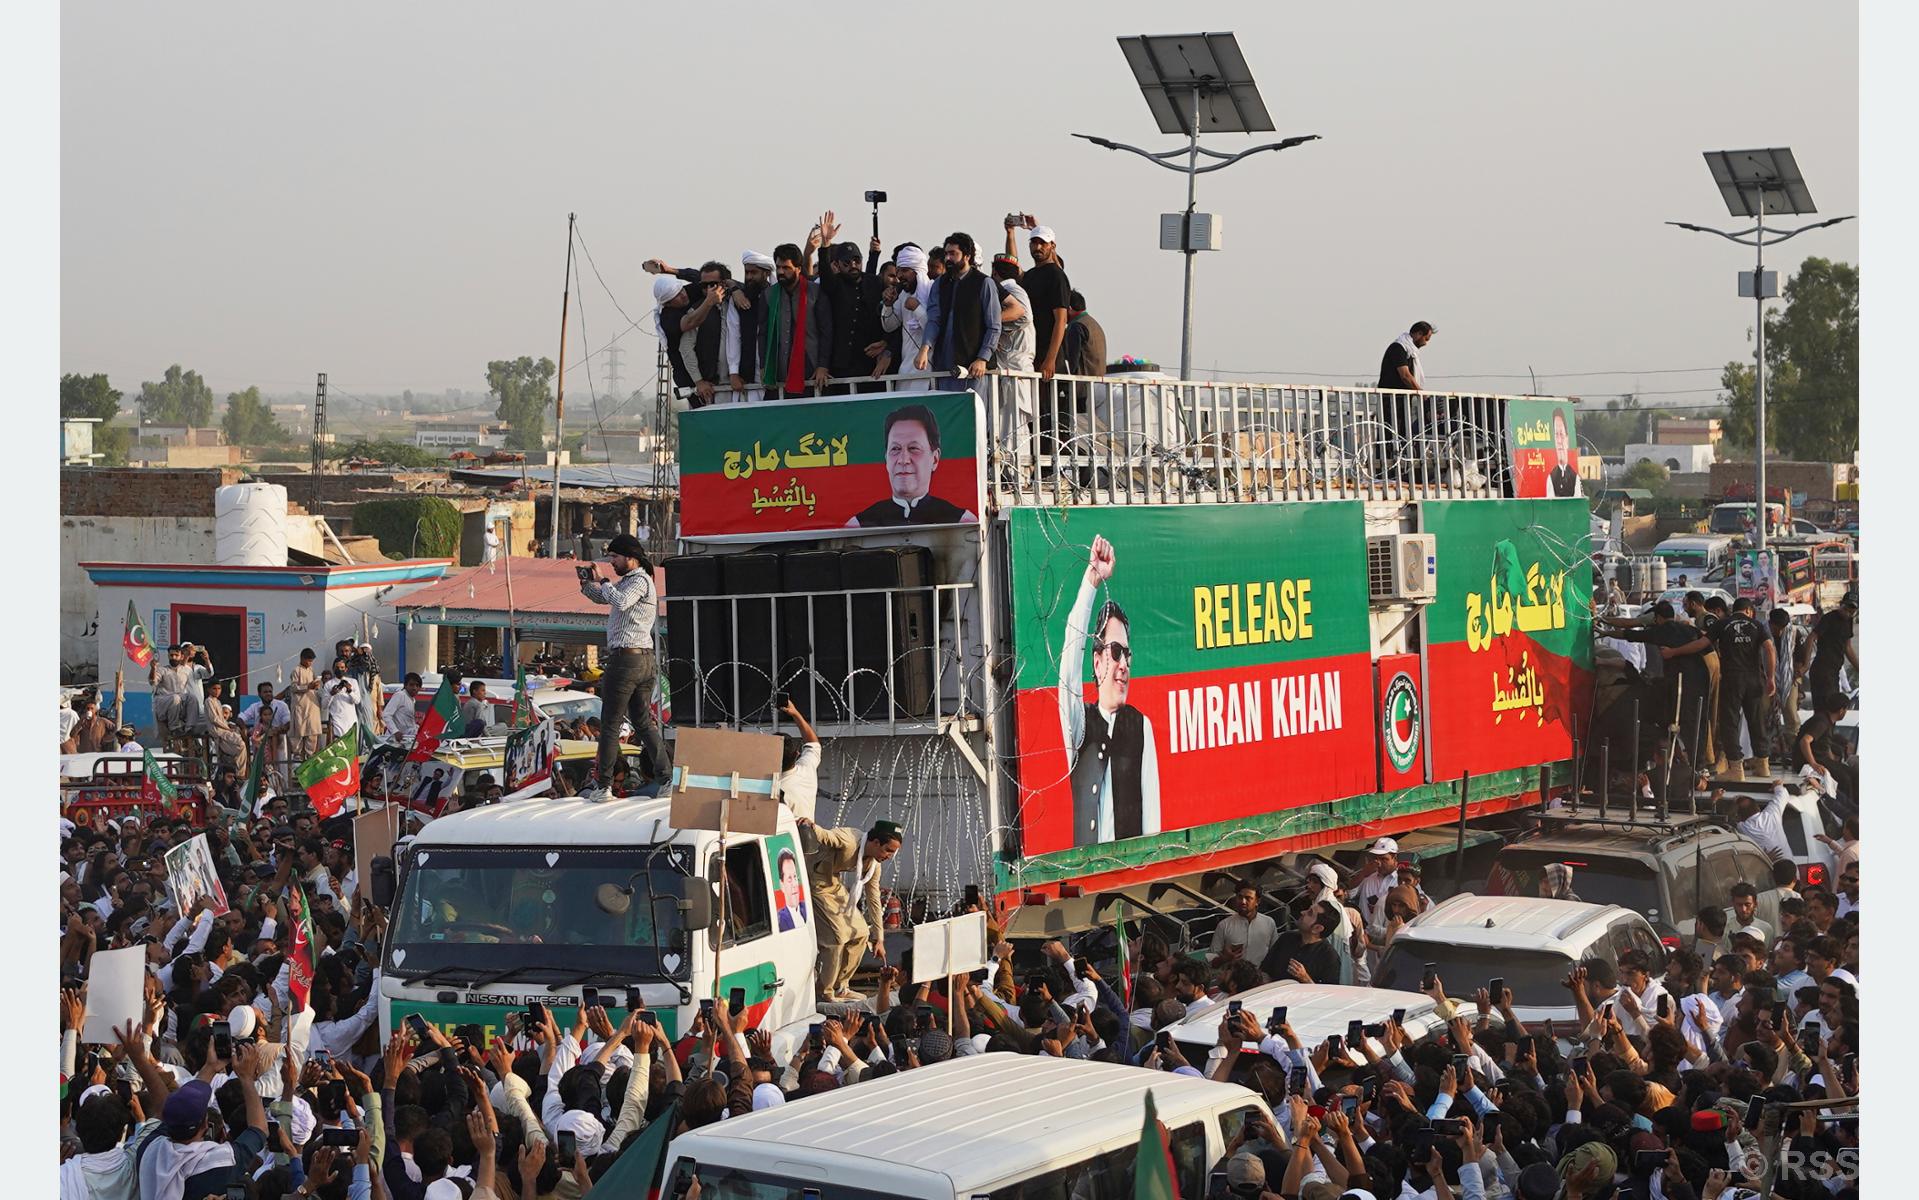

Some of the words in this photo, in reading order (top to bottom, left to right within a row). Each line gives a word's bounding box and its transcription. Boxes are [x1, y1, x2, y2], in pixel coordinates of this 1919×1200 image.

[723, 440, 781, 480] مارچ
[784, 432, 848, 469] لانگ
[1194, 579, 1313, 649] RELEASE
[1466, 573, 1514, 653] مارچ
[1516, 561, 1565, 632] لانگ
[1168, 683, 1262, 754] IMRAN
[1273, 671, 1342, 738] KHAN
[466, 994, 517, 1006] NISSAN
[525, 996, 579, 1007] DIESEL
